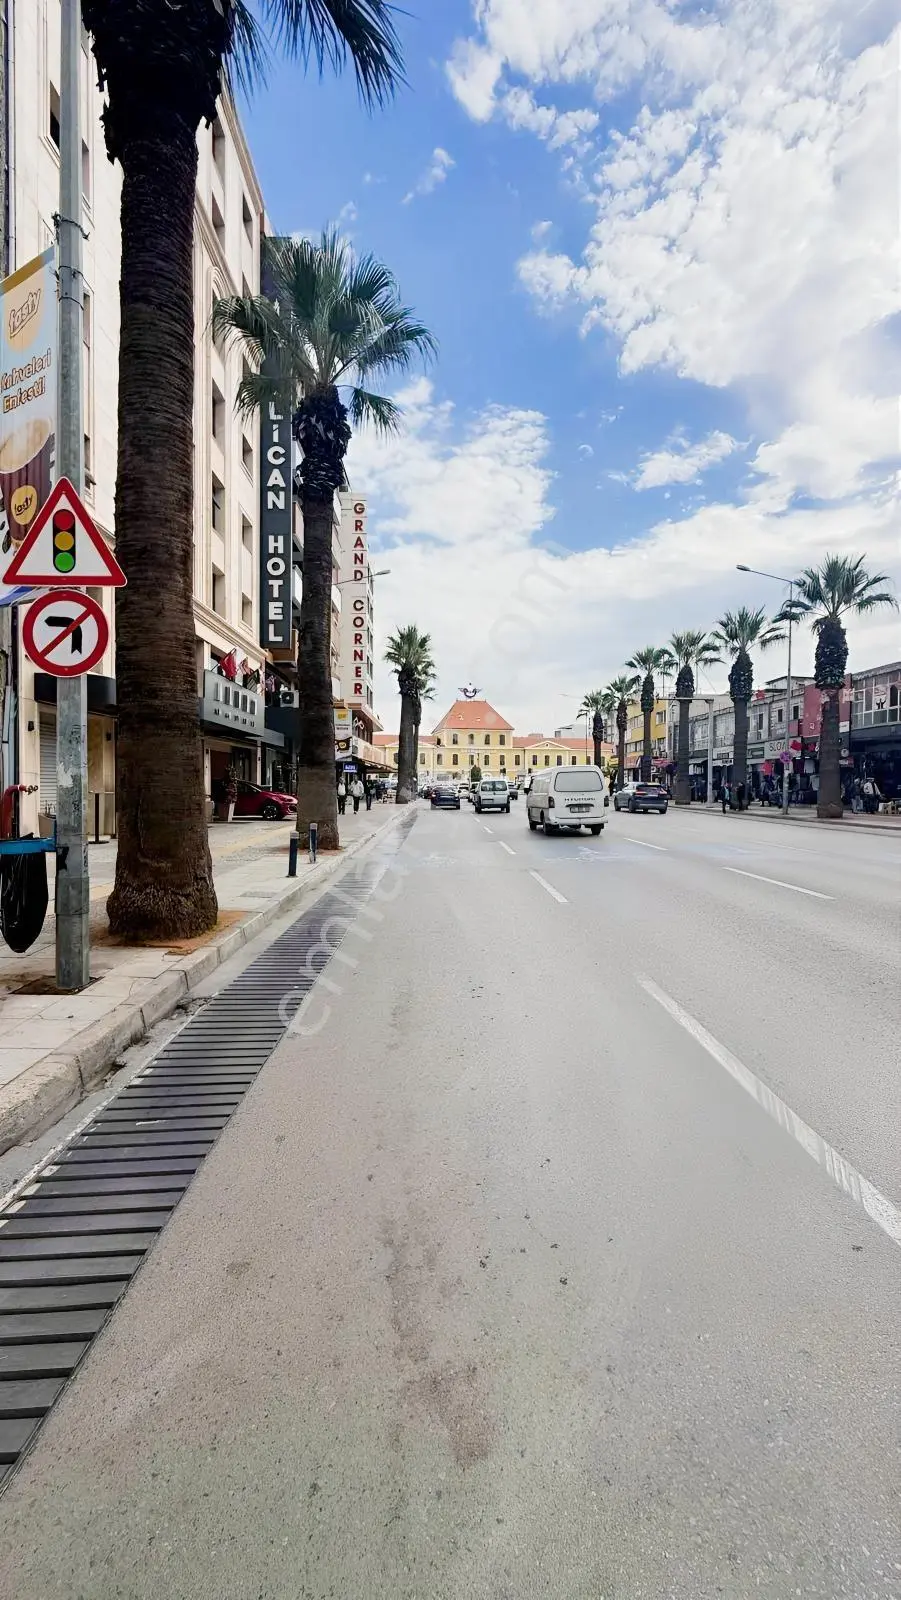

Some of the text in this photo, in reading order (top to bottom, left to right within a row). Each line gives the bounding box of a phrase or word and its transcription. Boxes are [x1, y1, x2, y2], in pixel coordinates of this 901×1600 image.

[266, 534, 287, 642] HOTEL
[352, 502, 366, 695] GRAND CORNER
